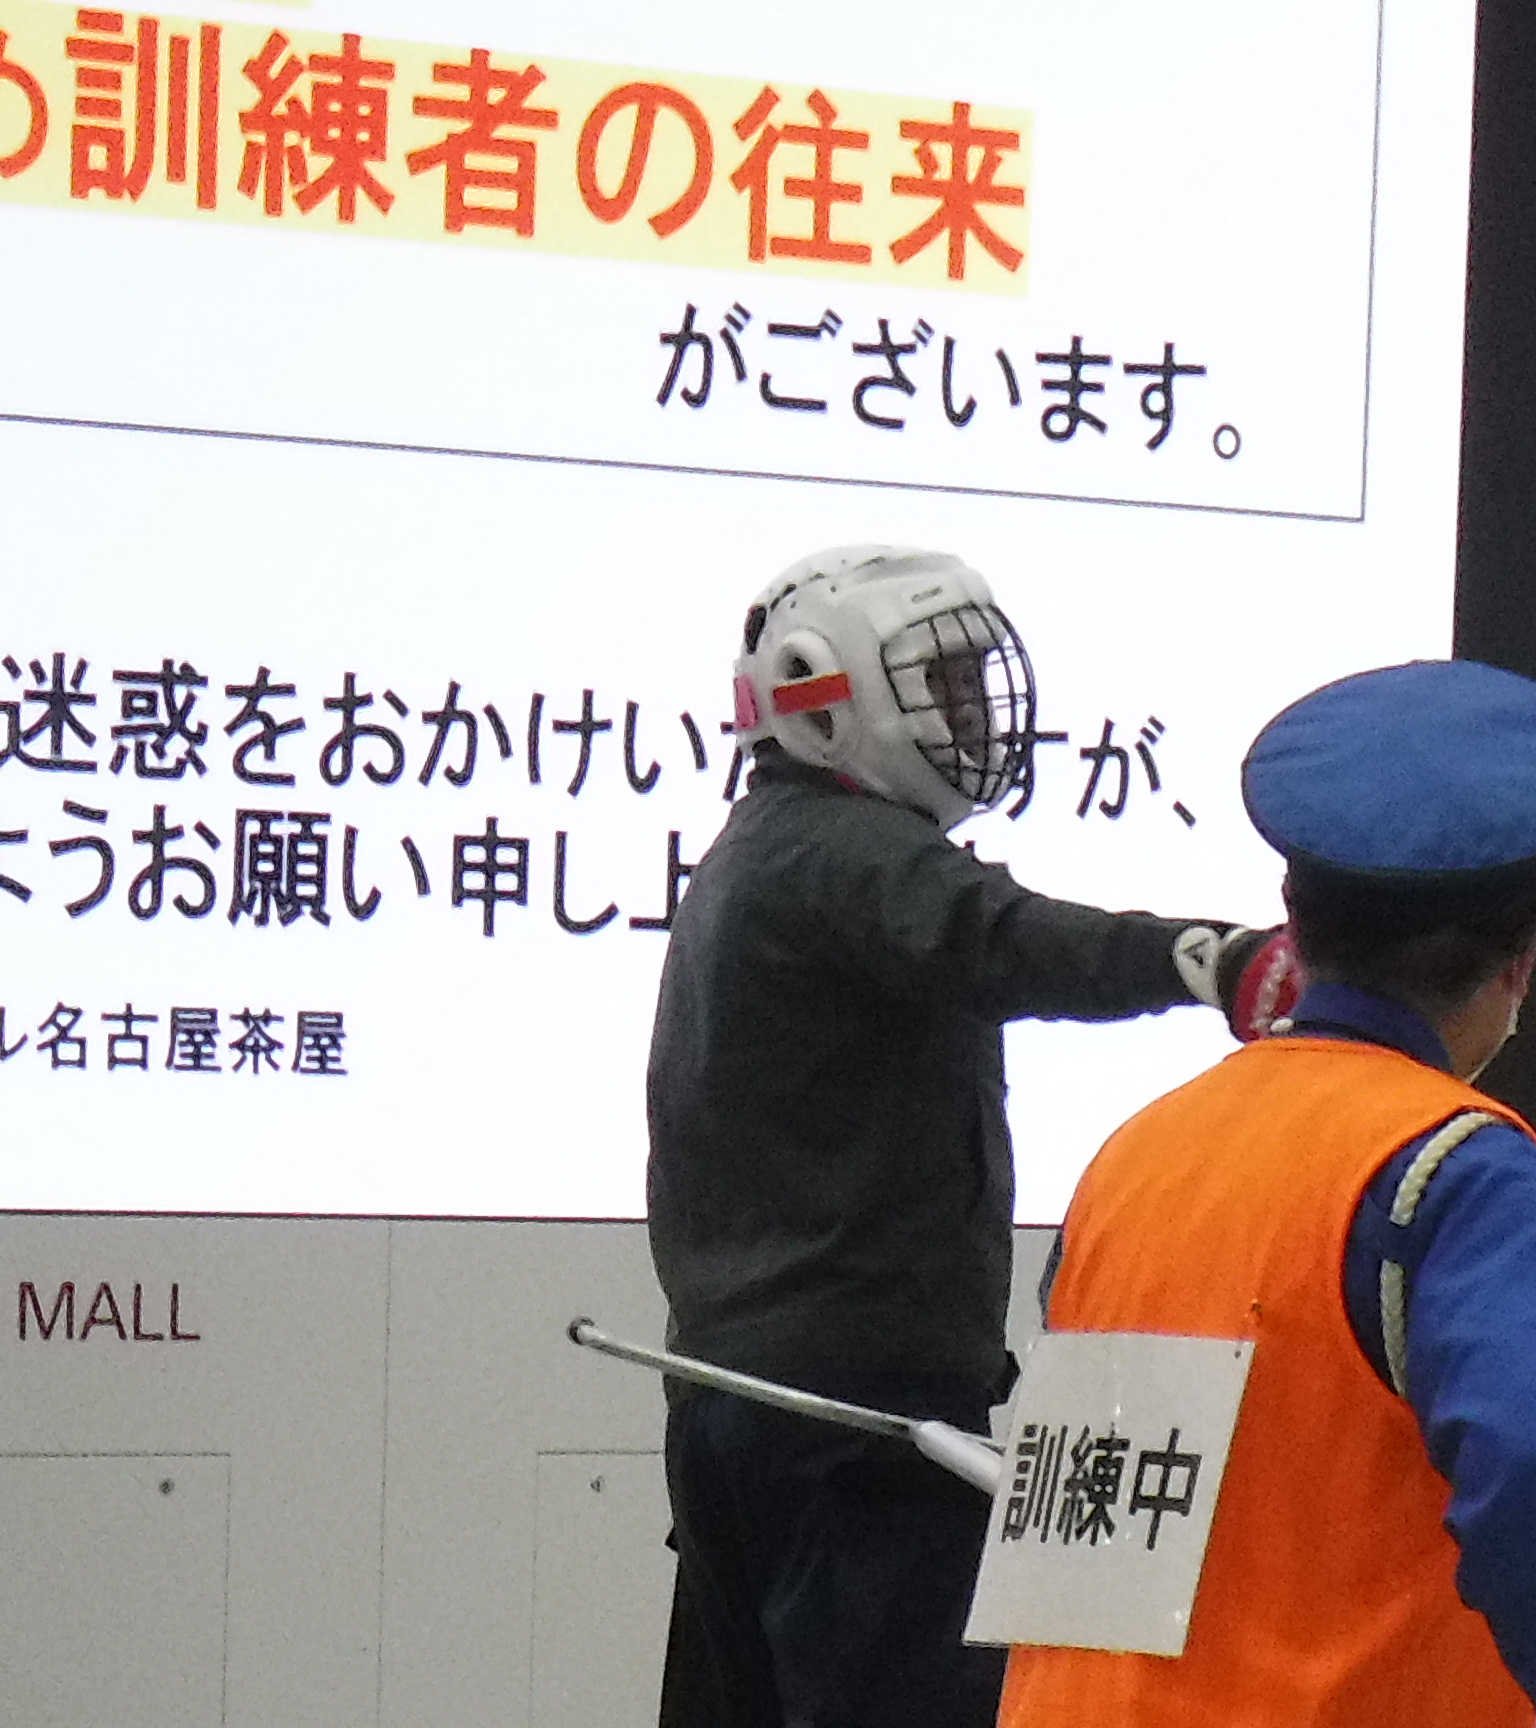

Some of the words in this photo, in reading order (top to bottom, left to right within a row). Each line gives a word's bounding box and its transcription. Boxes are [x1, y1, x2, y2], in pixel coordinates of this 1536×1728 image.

[656, 301, 1242, 461] がございます。
[19, 1281, 201, 1341] MALL
[1002, 1421, 1202, 1551] 訓練中
